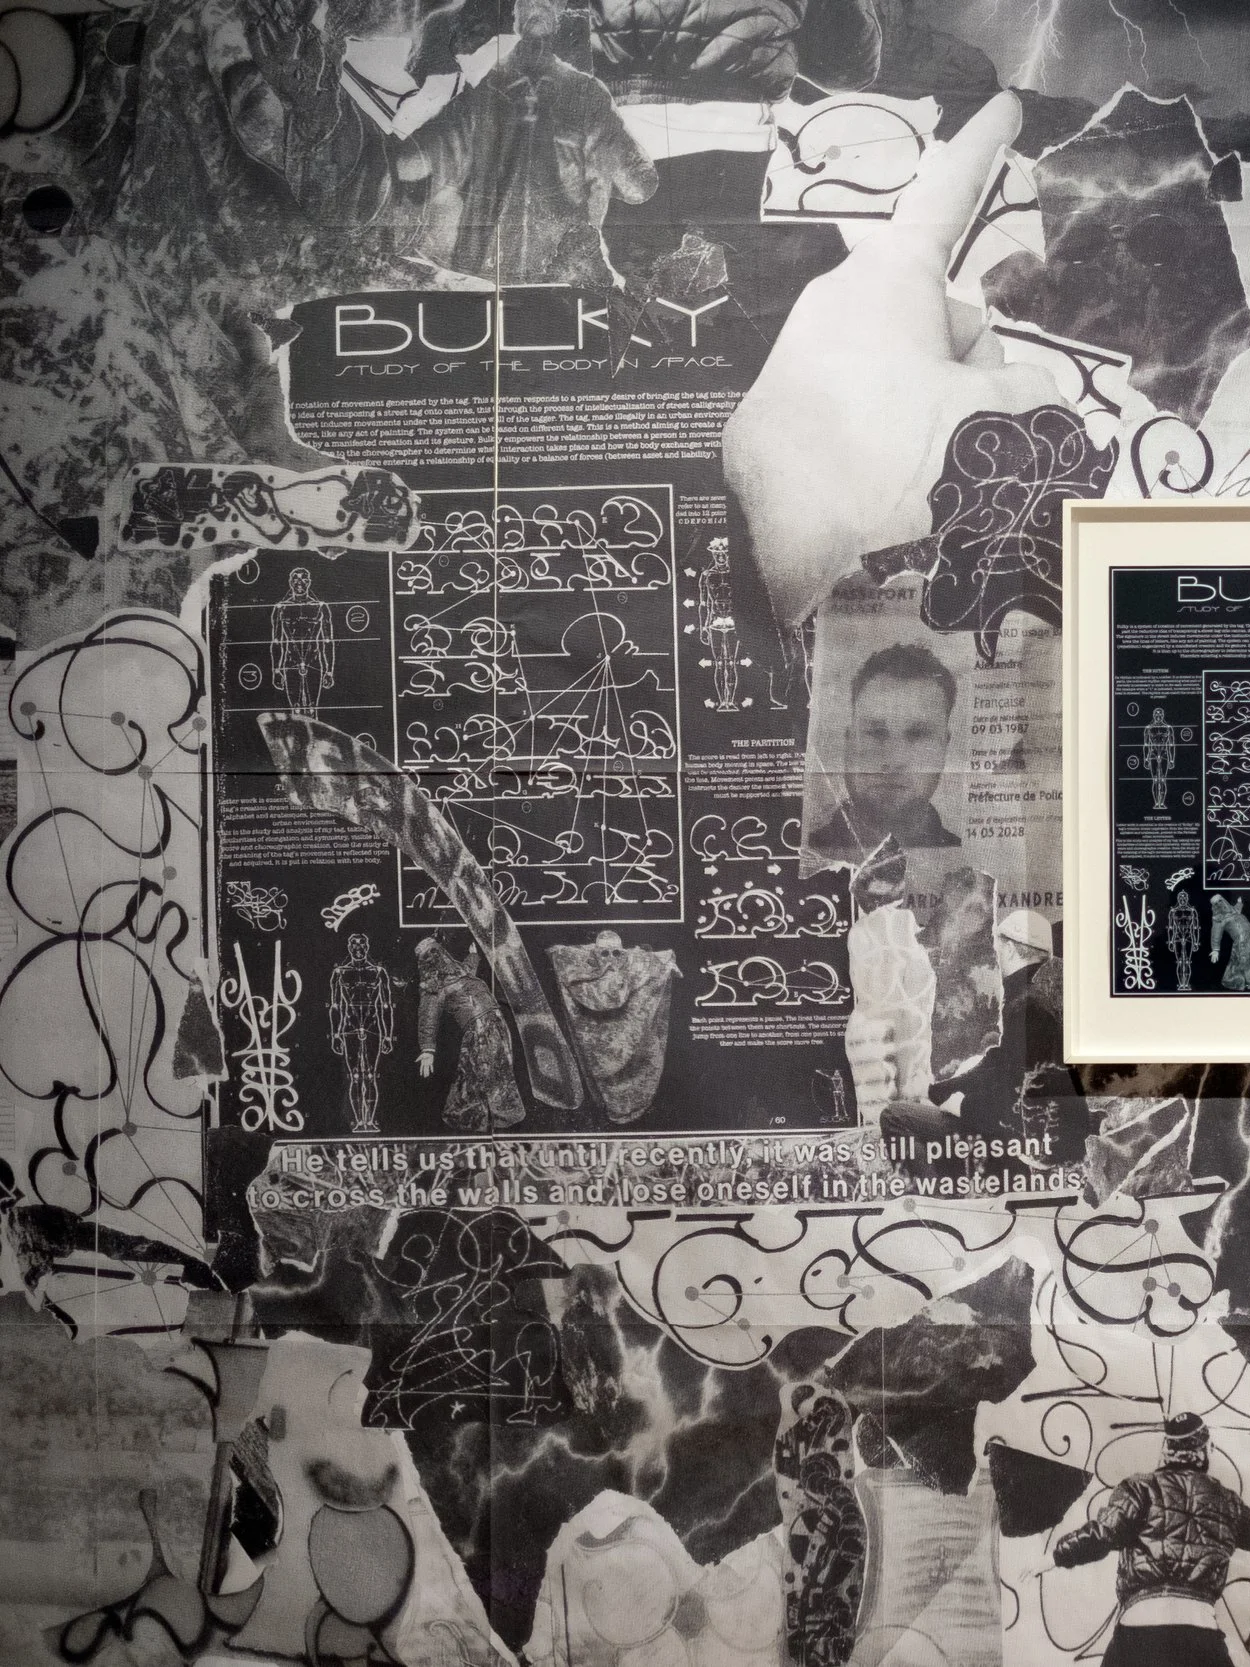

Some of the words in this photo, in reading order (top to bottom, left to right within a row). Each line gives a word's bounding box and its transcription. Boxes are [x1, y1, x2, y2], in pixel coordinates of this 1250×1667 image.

[335, 296, 728, 357] BULKY
[335, 363, 420, 377] STUDY
[433, 361, 466, 373] OF
[480, 359, 530, 372] THE
[542, 358, 608, 371] BODY
[650, 356, 732, 369] SPACE
[386, 399, 426, 407] generated
[576, 394, 609, 405] primary
[646, 392, 680, 403] bringing
[543, 405, 574, 415] process
[690, 401, 736, 409] calligraphy
[614, 412, 645, 424] illegally
[560, 433, 608, 444] relationship
[650, 432, 677, 442] person
[568, 444, 589, 452] place
[640, 441, 659, 450] body
[660, 441, 702, 452] exchanges
[383, 456, 417, 466] entering
[974, 697, 1025, 709] Française
[972, 726, 986, 734] 09
[990, 725, 1002, 734] 03
[968, 792, 1020, 803] Préfecture
[1023, 792, 1035, 801] de
[282, 1150, 324, 1172] He
[337, 1147, 408, 1171] tells
[420, 1150, 454, 1171] us
[466, 1145, 530, 1170] that
[539, 1142, 607, 1168] until
[619, 1140, 752, 1169] recently,
[763, 1140, 783, 1163] it
[795, 1144, 850, 1162] was
[862, 1136, 915, 1161] still
[926, 1132, 1053, 1164] pleasant
[250, 1186, 282, 1208] to
[292, 1188, 385, 1208] cross
[397, 1184, 447, 1207] the
[458, 1180, 539, 1205] walls
[549, 1180, 602, 1203] and
[622, 1177, 686, 1202] lose
[698, 1174, 812, 1200] oneself
[823, 1172, 848, 1196] in
[859, 1171, 905, 1196] the
[917, 1169, 1082, 1195] wastelands
